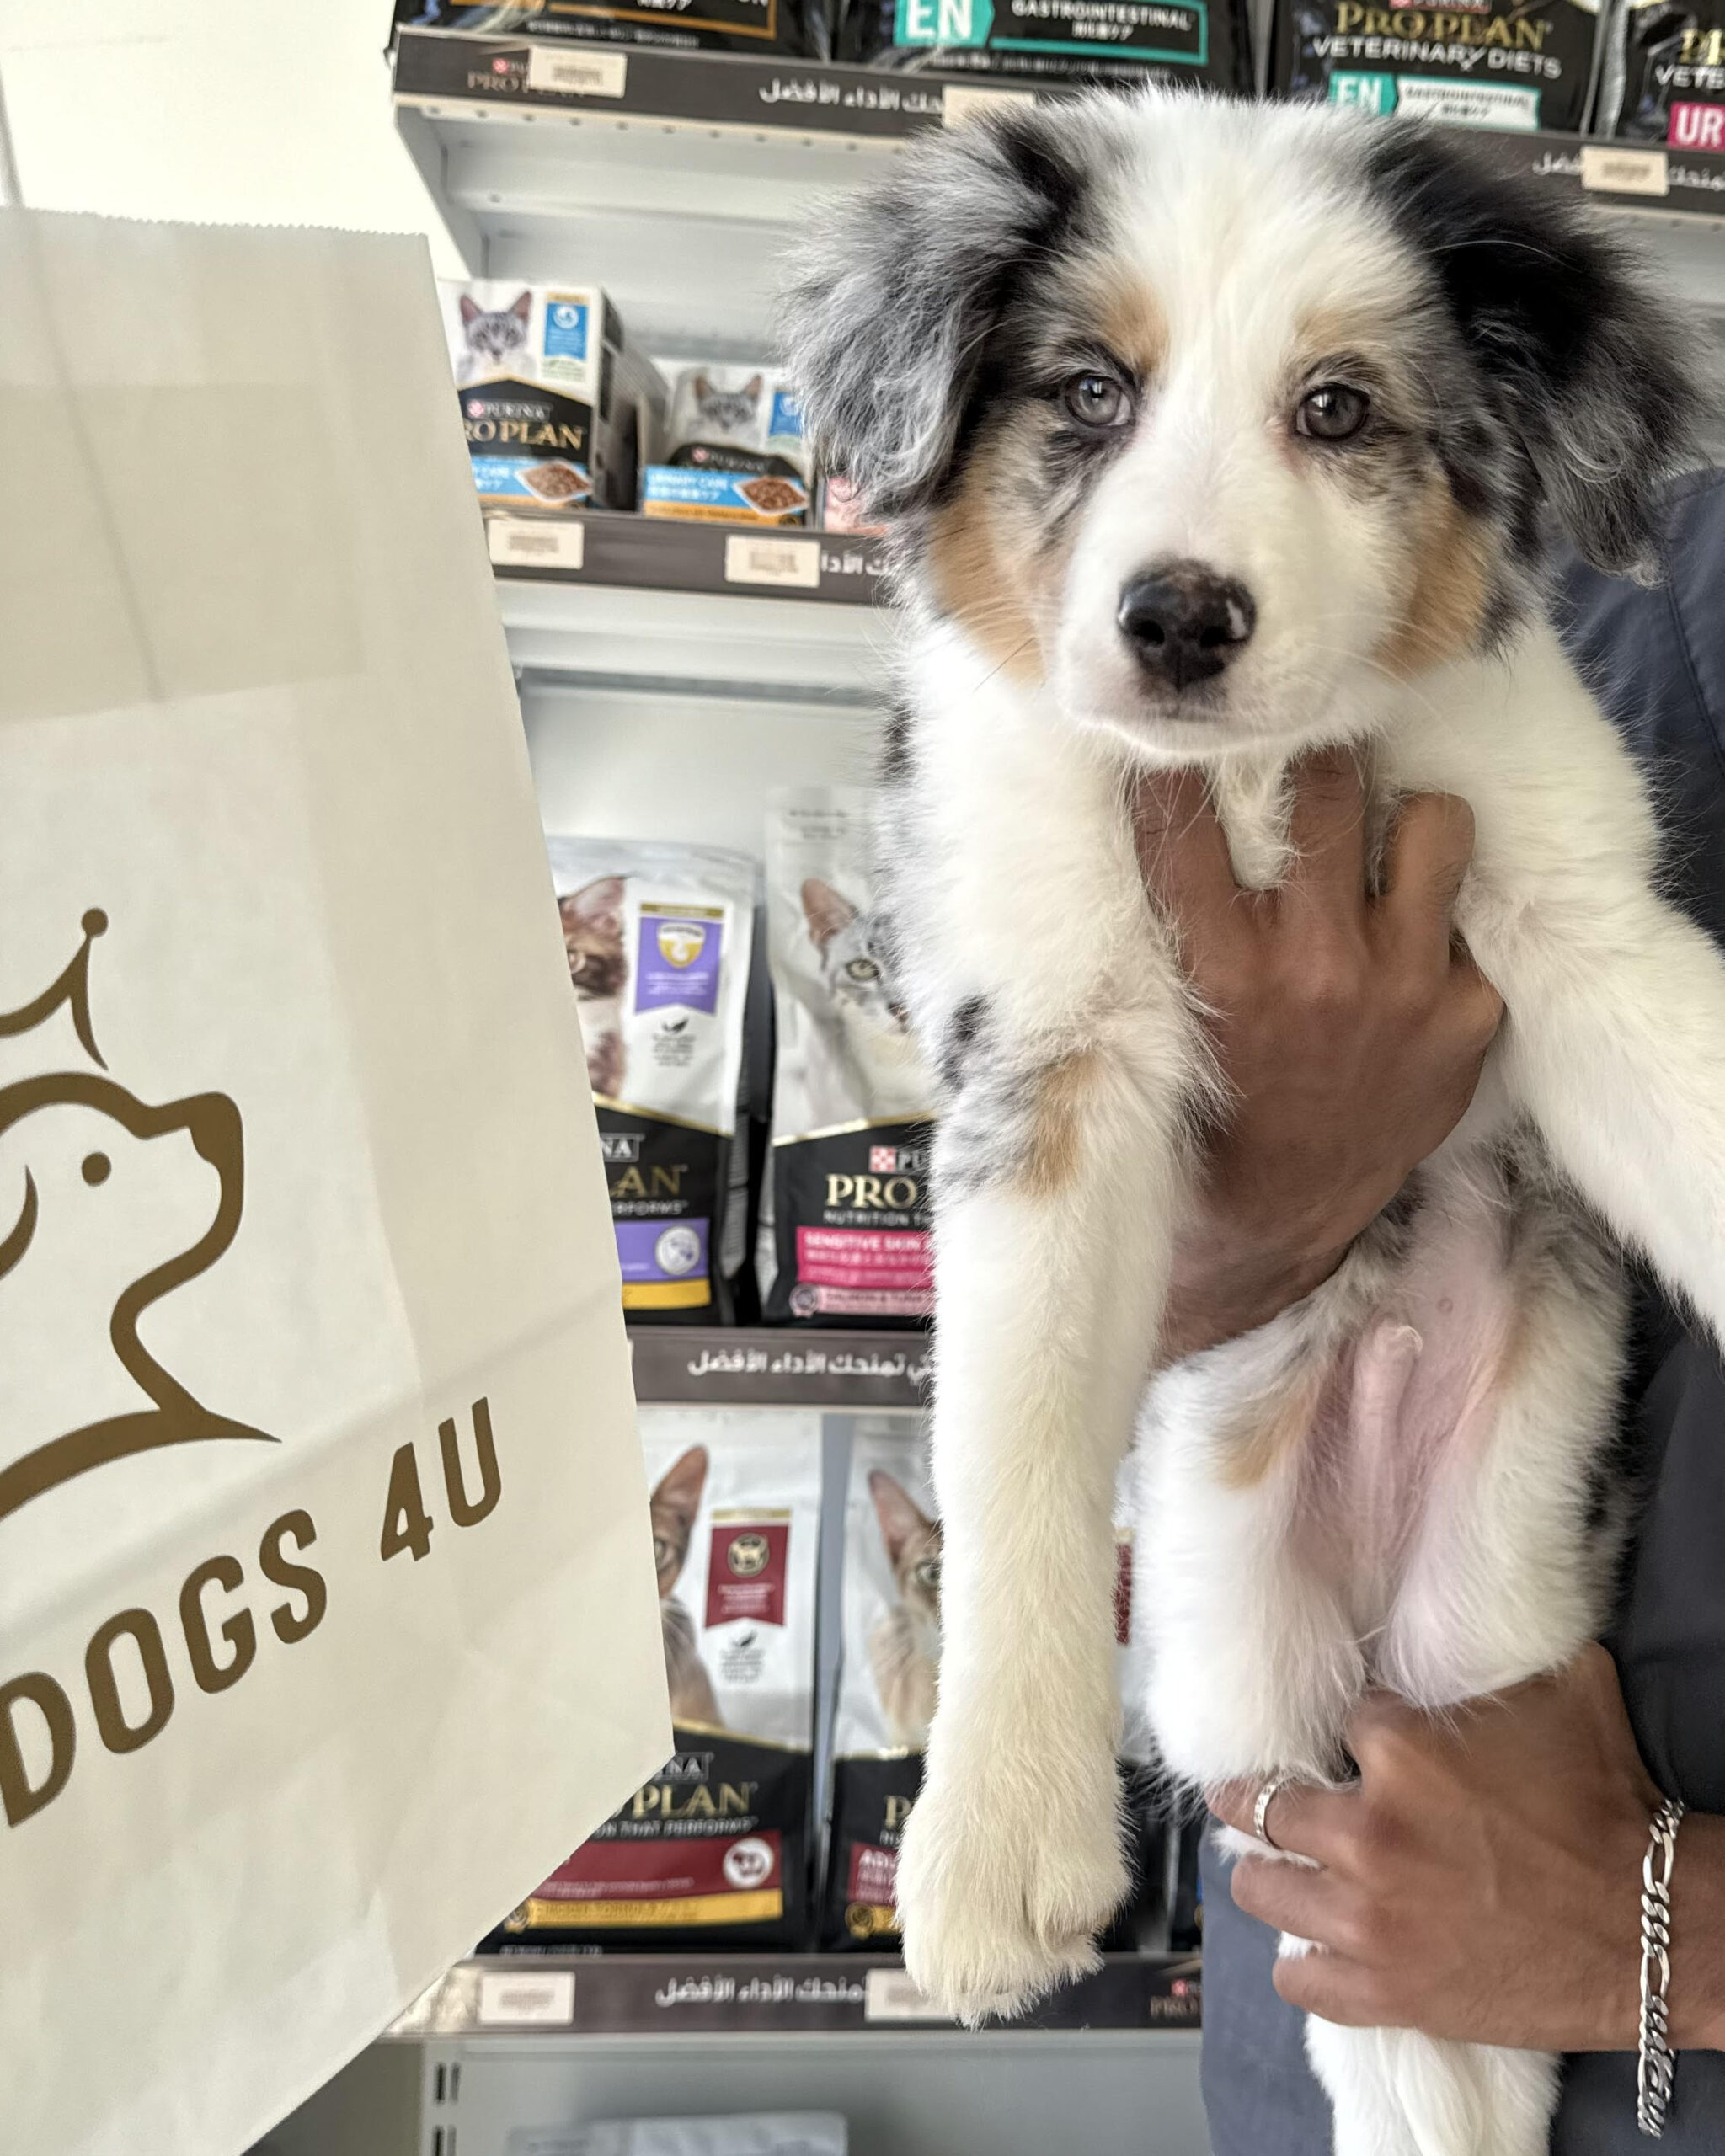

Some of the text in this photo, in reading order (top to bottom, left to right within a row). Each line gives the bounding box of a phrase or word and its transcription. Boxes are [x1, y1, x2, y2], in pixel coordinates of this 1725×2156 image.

[907, 0, 972, 40] EN
[1012, 0, 1192, 32] GASTROINTESTINAL
[1335, 2, 1546, 50] PRO PLAN
[1312, 35, 1562, 79] VETERINARY DIETS
[1675, 106, 1725, 148] UR
[486, 400, 547, 420] PURINA
[499, 419, 585, 451] PLAN
[825, 1173, 918, 1209] PRO
[823, 1209, 909, 1227] NUTRITION
[686, 1348, 768, 1377] الأفضل
[0, 1396, 502, 1828] DOGS 4U
[632, 1781, 750, 1819] PLAN
[655, 1973, 736, 2009] الأفضل
